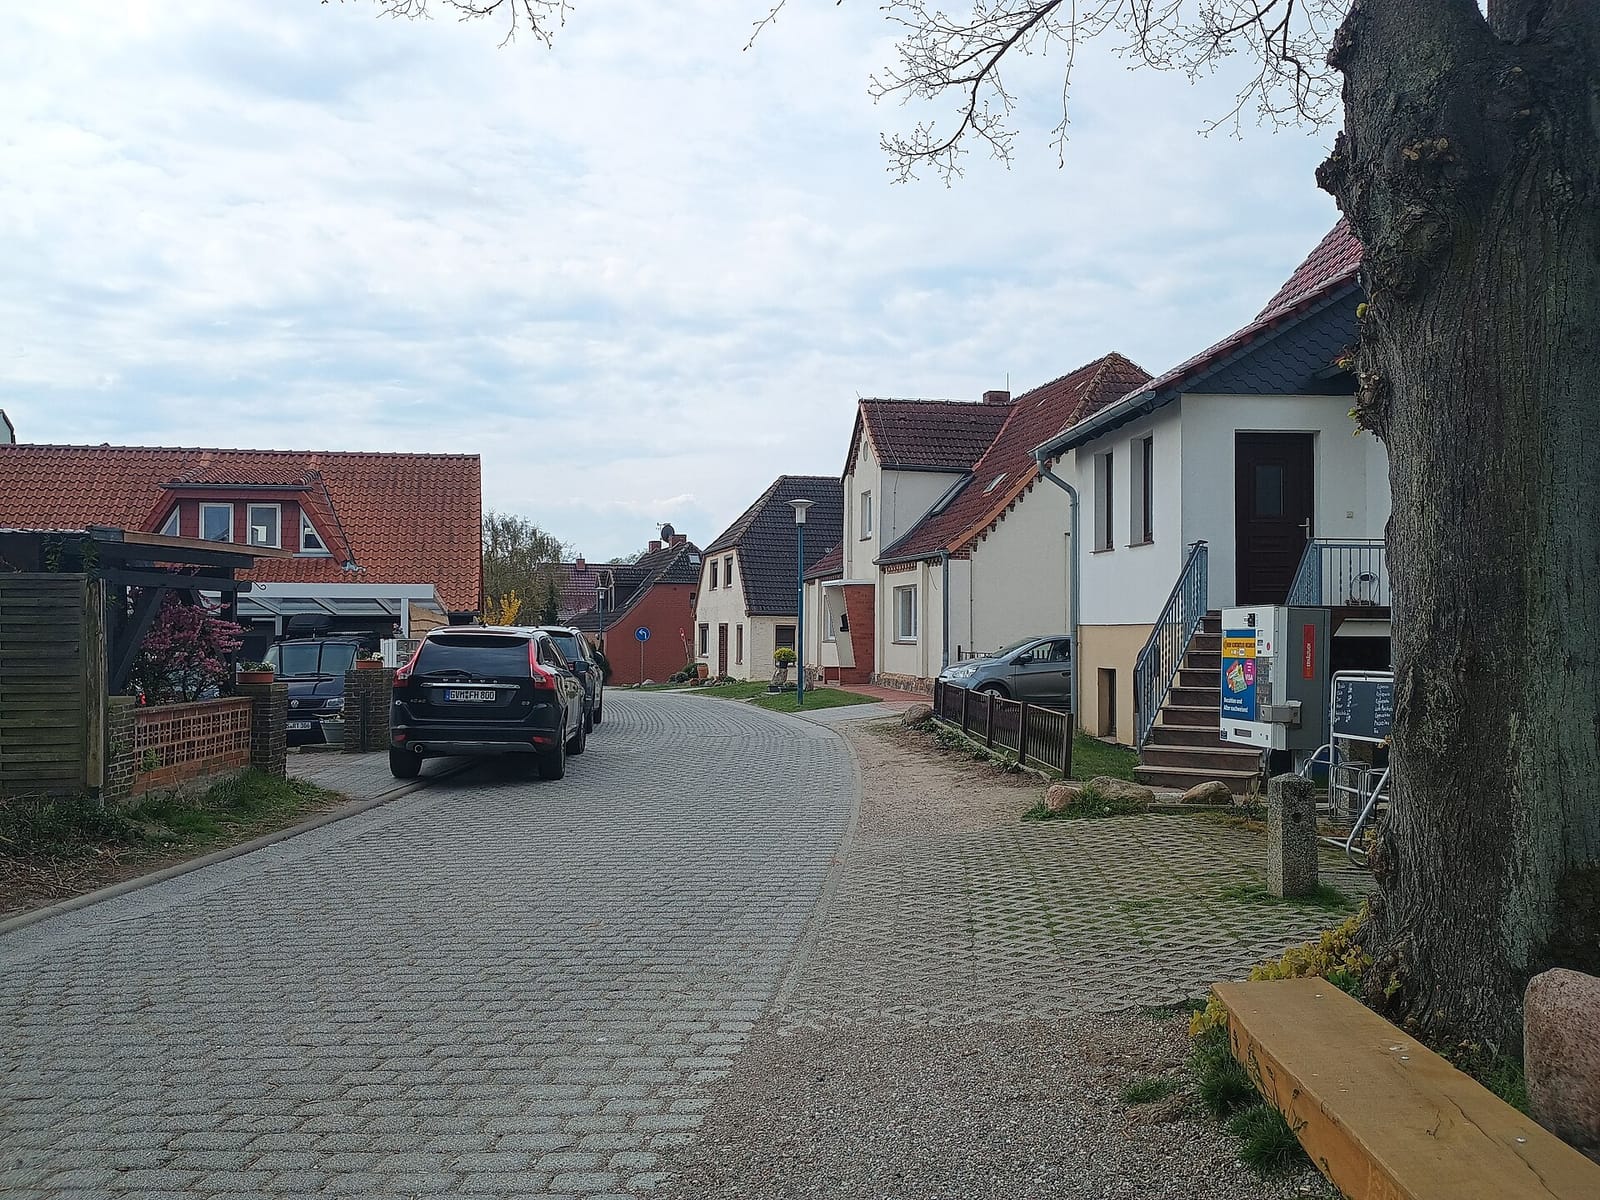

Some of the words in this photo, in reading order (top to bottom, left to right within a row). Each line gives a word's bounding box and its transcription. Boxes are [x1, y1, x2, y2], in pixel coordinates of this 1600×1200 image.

[450, 690, 465, 700] GVM
[469, 691, 480, 700] FH
[480, 691, 495, 700] 800
